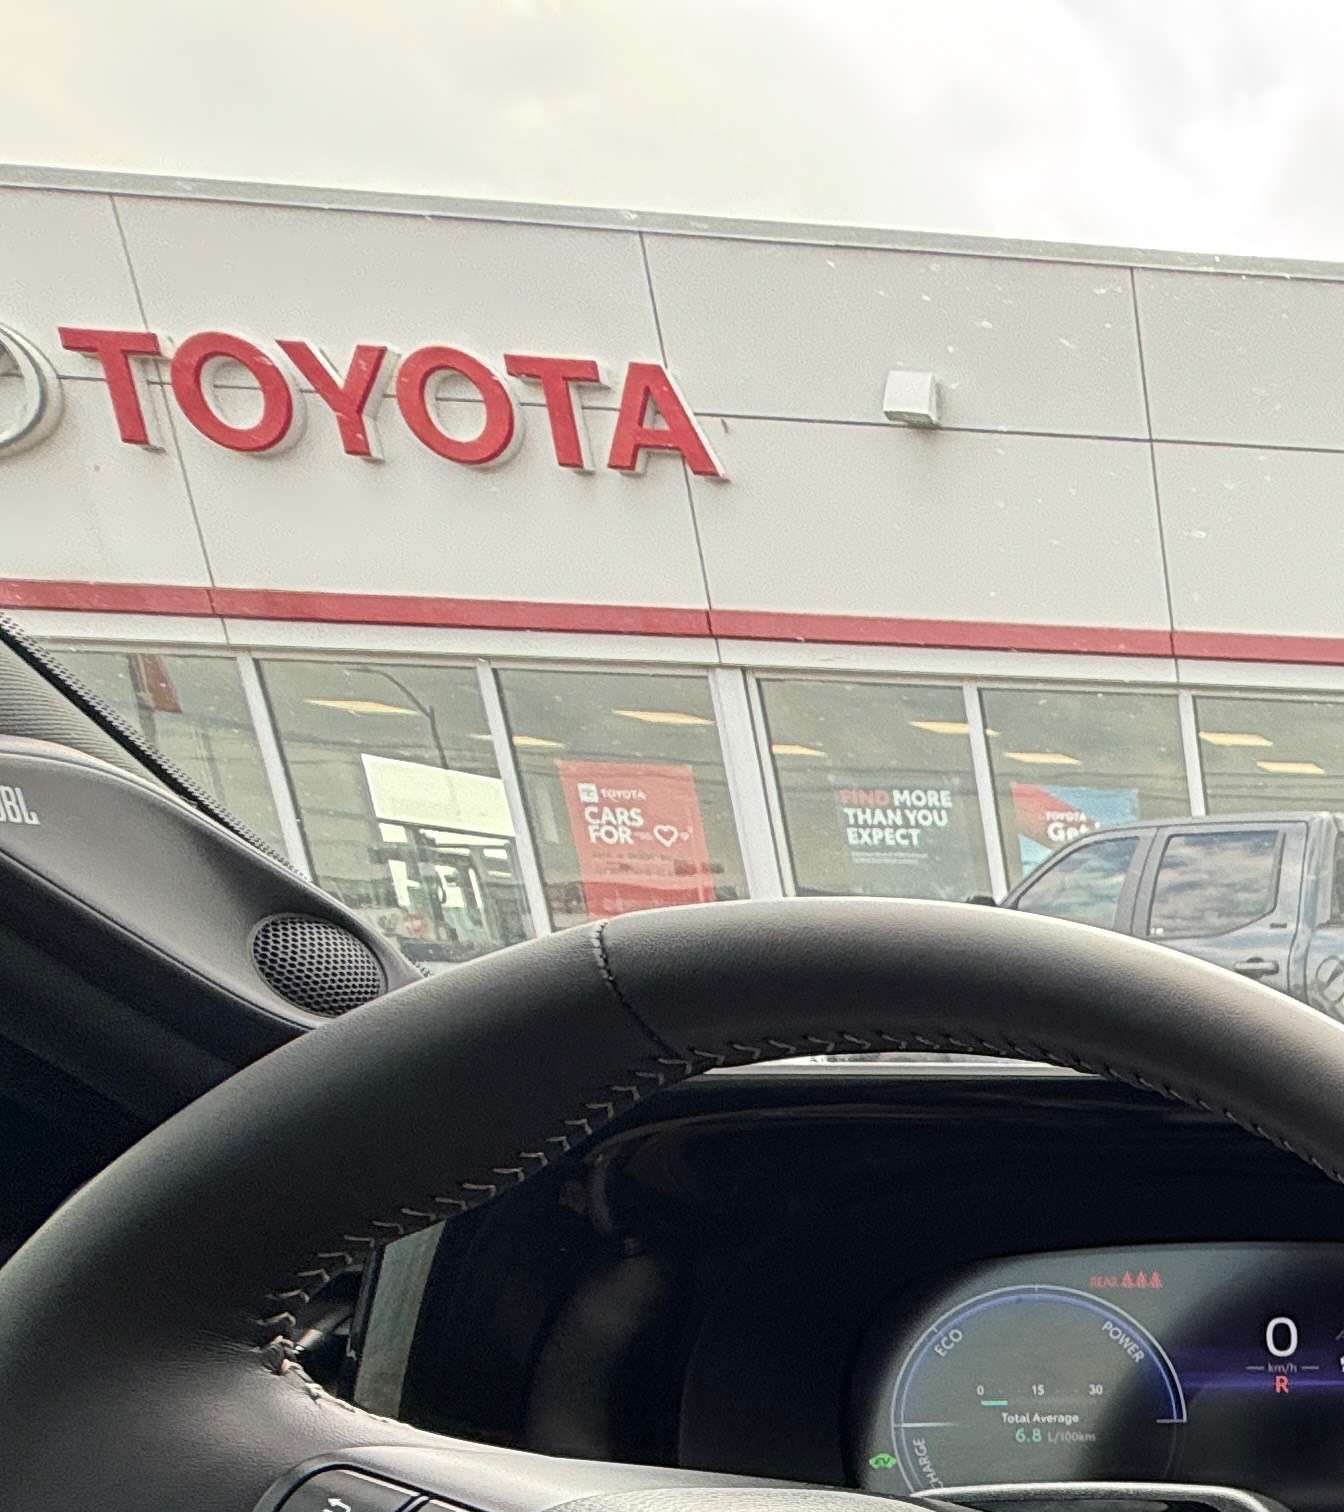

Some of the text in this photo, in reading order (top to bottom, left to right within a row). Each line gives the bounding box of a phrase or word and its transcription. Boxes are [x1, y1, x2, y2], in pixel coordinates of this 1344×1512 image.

[58, 325, 728, 481] TOYOTA
[839, 789, 953, 808] FIND MORE
[584, 806, 644, 827] CARS
[844, 807, 949, 826] THAN YOU
[588, 825, 634, 845] FOR
[846, 826, 921, 846] EXPECT
[934, 1328, 963, 1357] ECO
[1102, 1320, 1145, 1364] POWER
[1265, 1317, 1298, 1358] 0
[1267, 1362, 1298, 1374] km/h
[975, 1384, 1104, 1396] 0 15 30
[1275, 1375, 1289, 1394] R
[1002, 1412, 1080, 1427] Total Average
[1015, 1427, 1097, 1444] 6.8 L/100km
